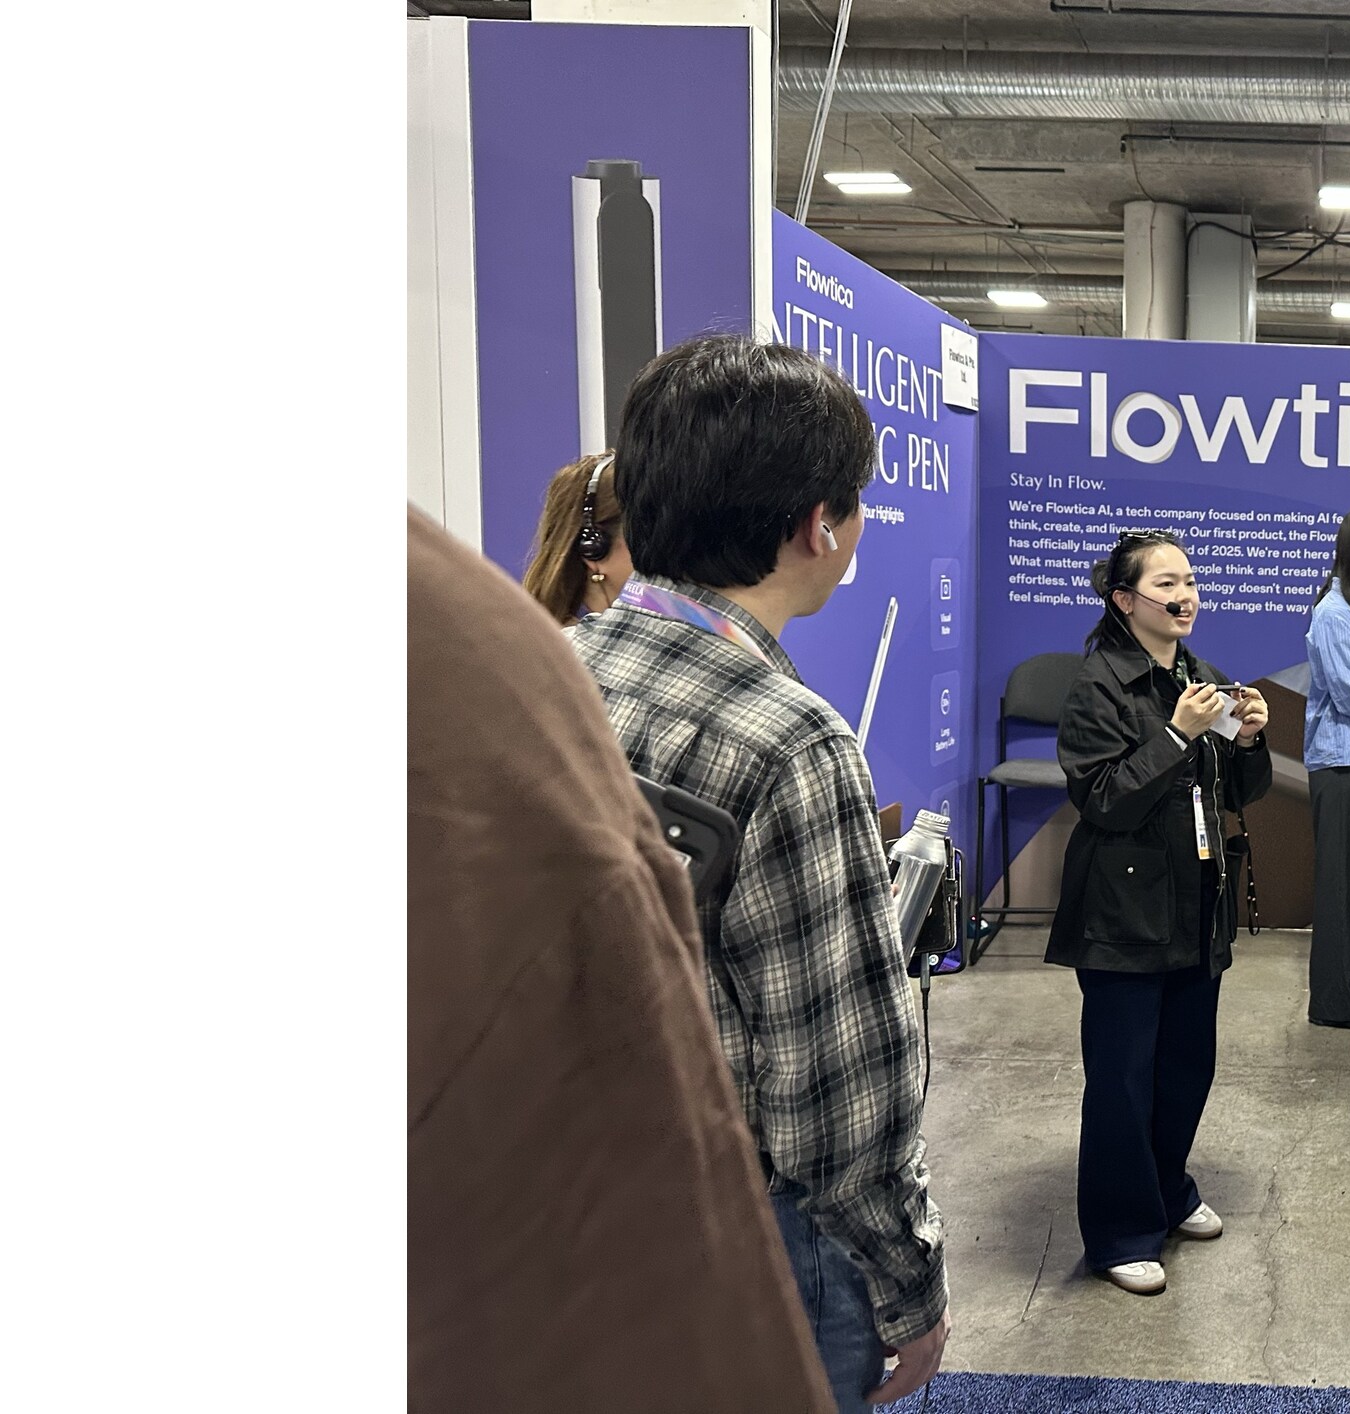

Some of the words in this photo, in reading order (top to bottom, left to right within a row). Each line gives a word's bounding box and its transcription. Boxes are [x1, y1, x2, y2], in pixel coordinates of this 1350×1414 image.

[796, 256, 854, 309] Flowtica
[908, 434, 948, 493] PEN
[1011, 473, 1043, 491] Stay
[1049, 475, 1062, 488] In
[1069, 476, 1106, 490] Flow.
[1009, 500, 1043, 512] We're
[1046, 502, 1095, 514] Flowtica
[1098, 505, 1113, 517] AI,
[1126, 506, 1151, 517] tech
[1154, 510, 1206, 521] company
[1209, 509, 1254, 521] focused
[1257, 513, 1271, 521] on
[1274, 512, 1314, 525] making
[1317, 513, 1329, 523] AI
[1009, 519, 1041, 532] think,
[1044, 522, 1083, 533] create,
[1086, 523, 1107, 533] and
[1190, 526, 1211, 537] Our
[1213, 527, 1236, 538] first
[1239, 529, 1286, 541] product,
[1289, 530, 1307, 541] the
[1310, 531, 1338, 541] Flow
[1009, 537, 1030, 548] has
[1032, 538, 1080, 552] officially
[1197, 545, 1209, 555] of
[1212, 545, 1244, 556] 2025.
[1247, 547, 1280, 558] We're
[1282, 549, 1301, 558] not
[1304, 549, 1329, 559] here
[1009, 555, 1041, 567] What
[1045, 558, 1090, 569] matters
[1191, 563, 1222, 576] eople
[1226, 564, 1254, 575] think
[1258, 566, 1278, 576] and
[1282, 567, 1318, 577] create
[1009, 573, 1067, 586] effortless.
[1198, 581, 1235, 595] nology
[1239, 583, 1280, 594] doesn't
[1284, 585, 1312, 594] need
[1009, 591, 1031, 602] feel
[1033, 592, 1073, 605] simple,
[1221, 600, 1262, 613] change
[1265, 601, 1283, 611] the
[1286, 604, 1309, 615] way
